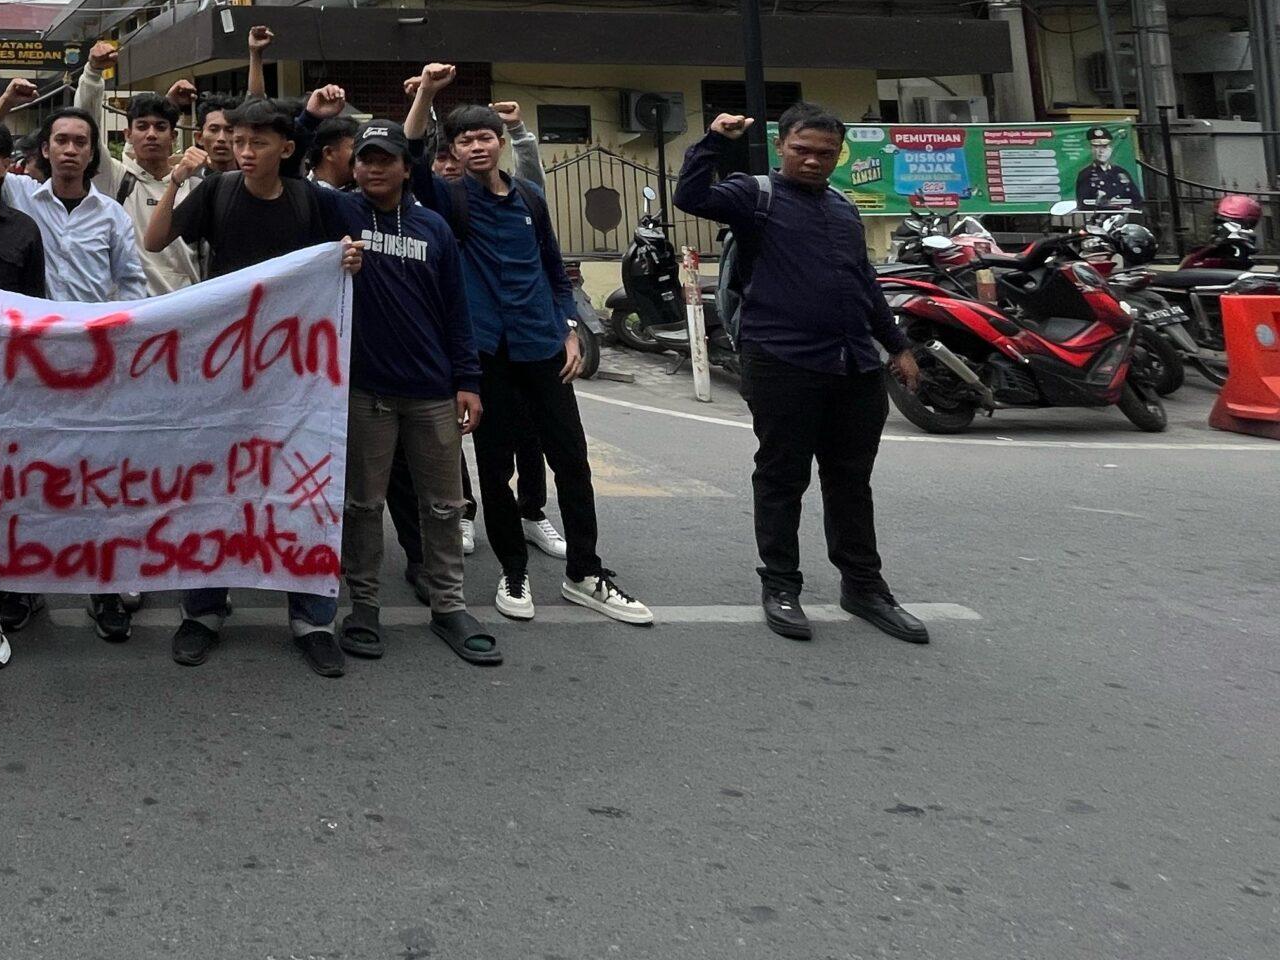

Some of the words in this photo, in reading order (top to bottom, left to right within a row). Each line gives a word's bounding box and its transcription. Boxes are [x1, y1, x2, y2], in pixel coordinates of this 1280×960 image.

[18, 50, 62, 60] MEDAN
[895, 134, 961, 143] PEMUTIHAN
[905, 153, 956, 163] DISKON
[909, 163, 954, 173] PAJAK
[383, 233, 428, 262] INSIGHT
[201, 283, 343, 392] dan
